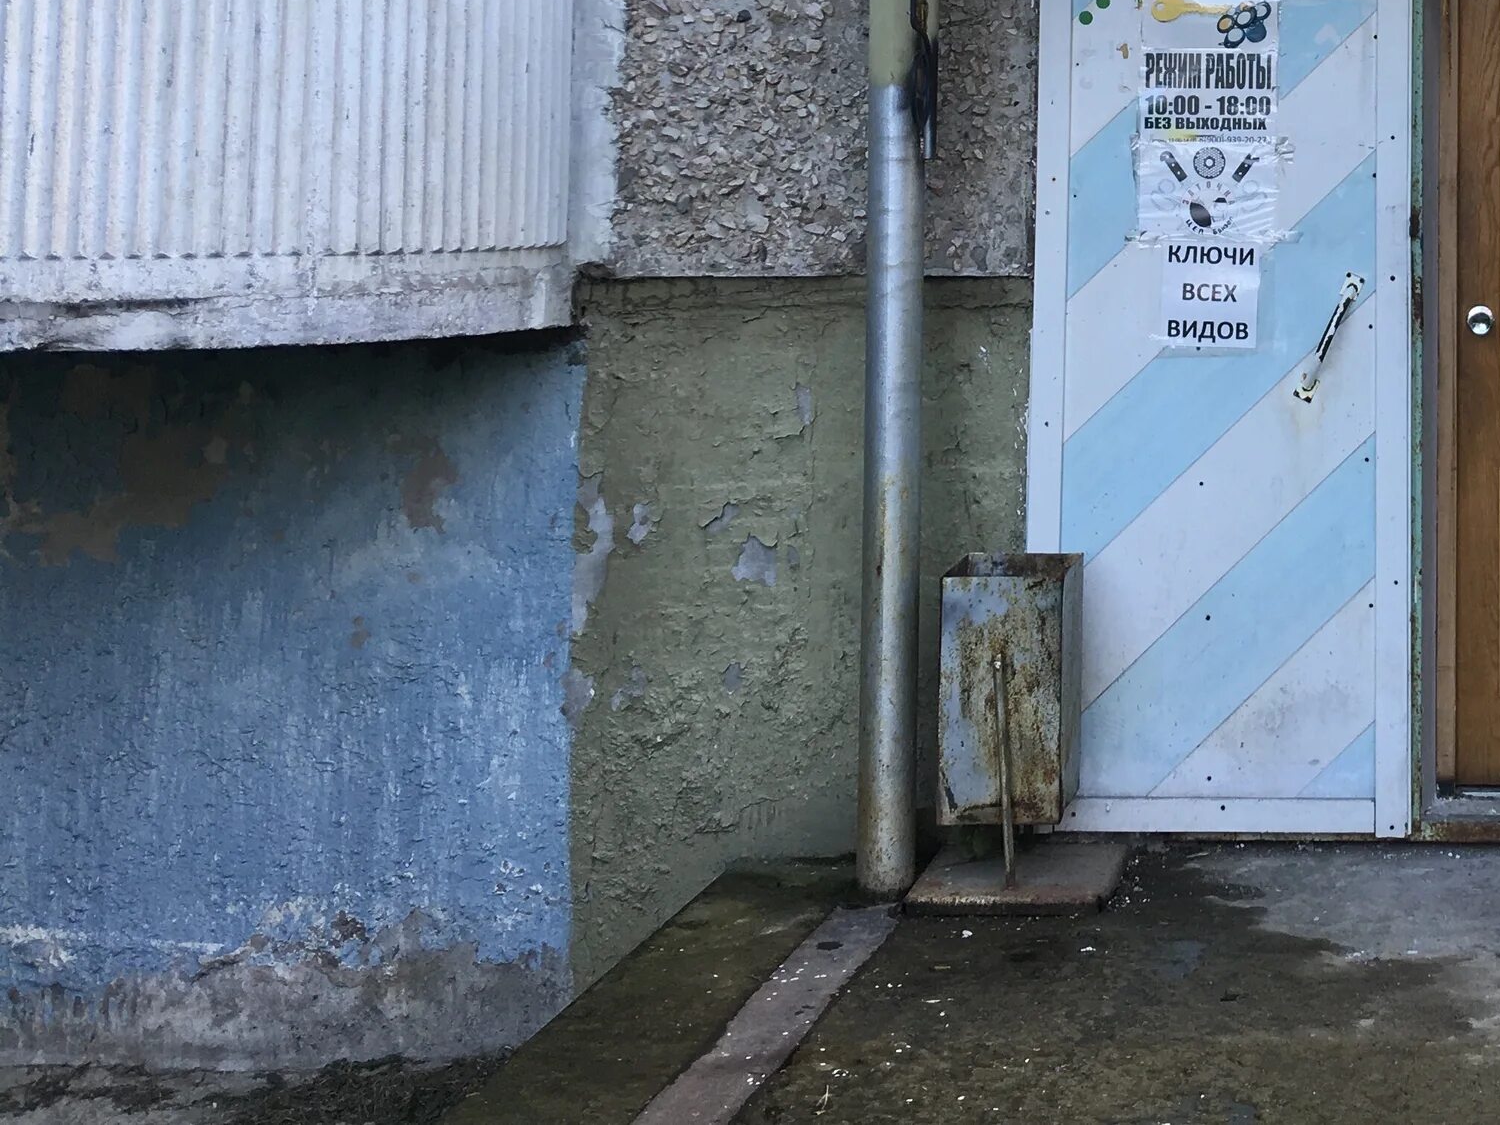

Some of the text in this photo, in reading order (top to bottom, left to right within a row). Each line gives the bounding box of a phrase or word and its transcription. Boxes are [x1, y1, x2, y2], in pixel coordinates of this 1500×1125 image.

[1145, 53, 1272, 90] РЕЖИМ РАБОТЫ
[1145, 95, 1199, 115] 10:00
[1216, 95, 1271, 116] 18:00
[1144, 117, 1267, 131] БЕЗ ВЫХОДНЫХ
[1168, 245, 1255, 266] КЛЮЧИ
[1182, 283, 1237, 303] ВСЕХ
[1167, 320, 1249, 343] ВИДОВ
